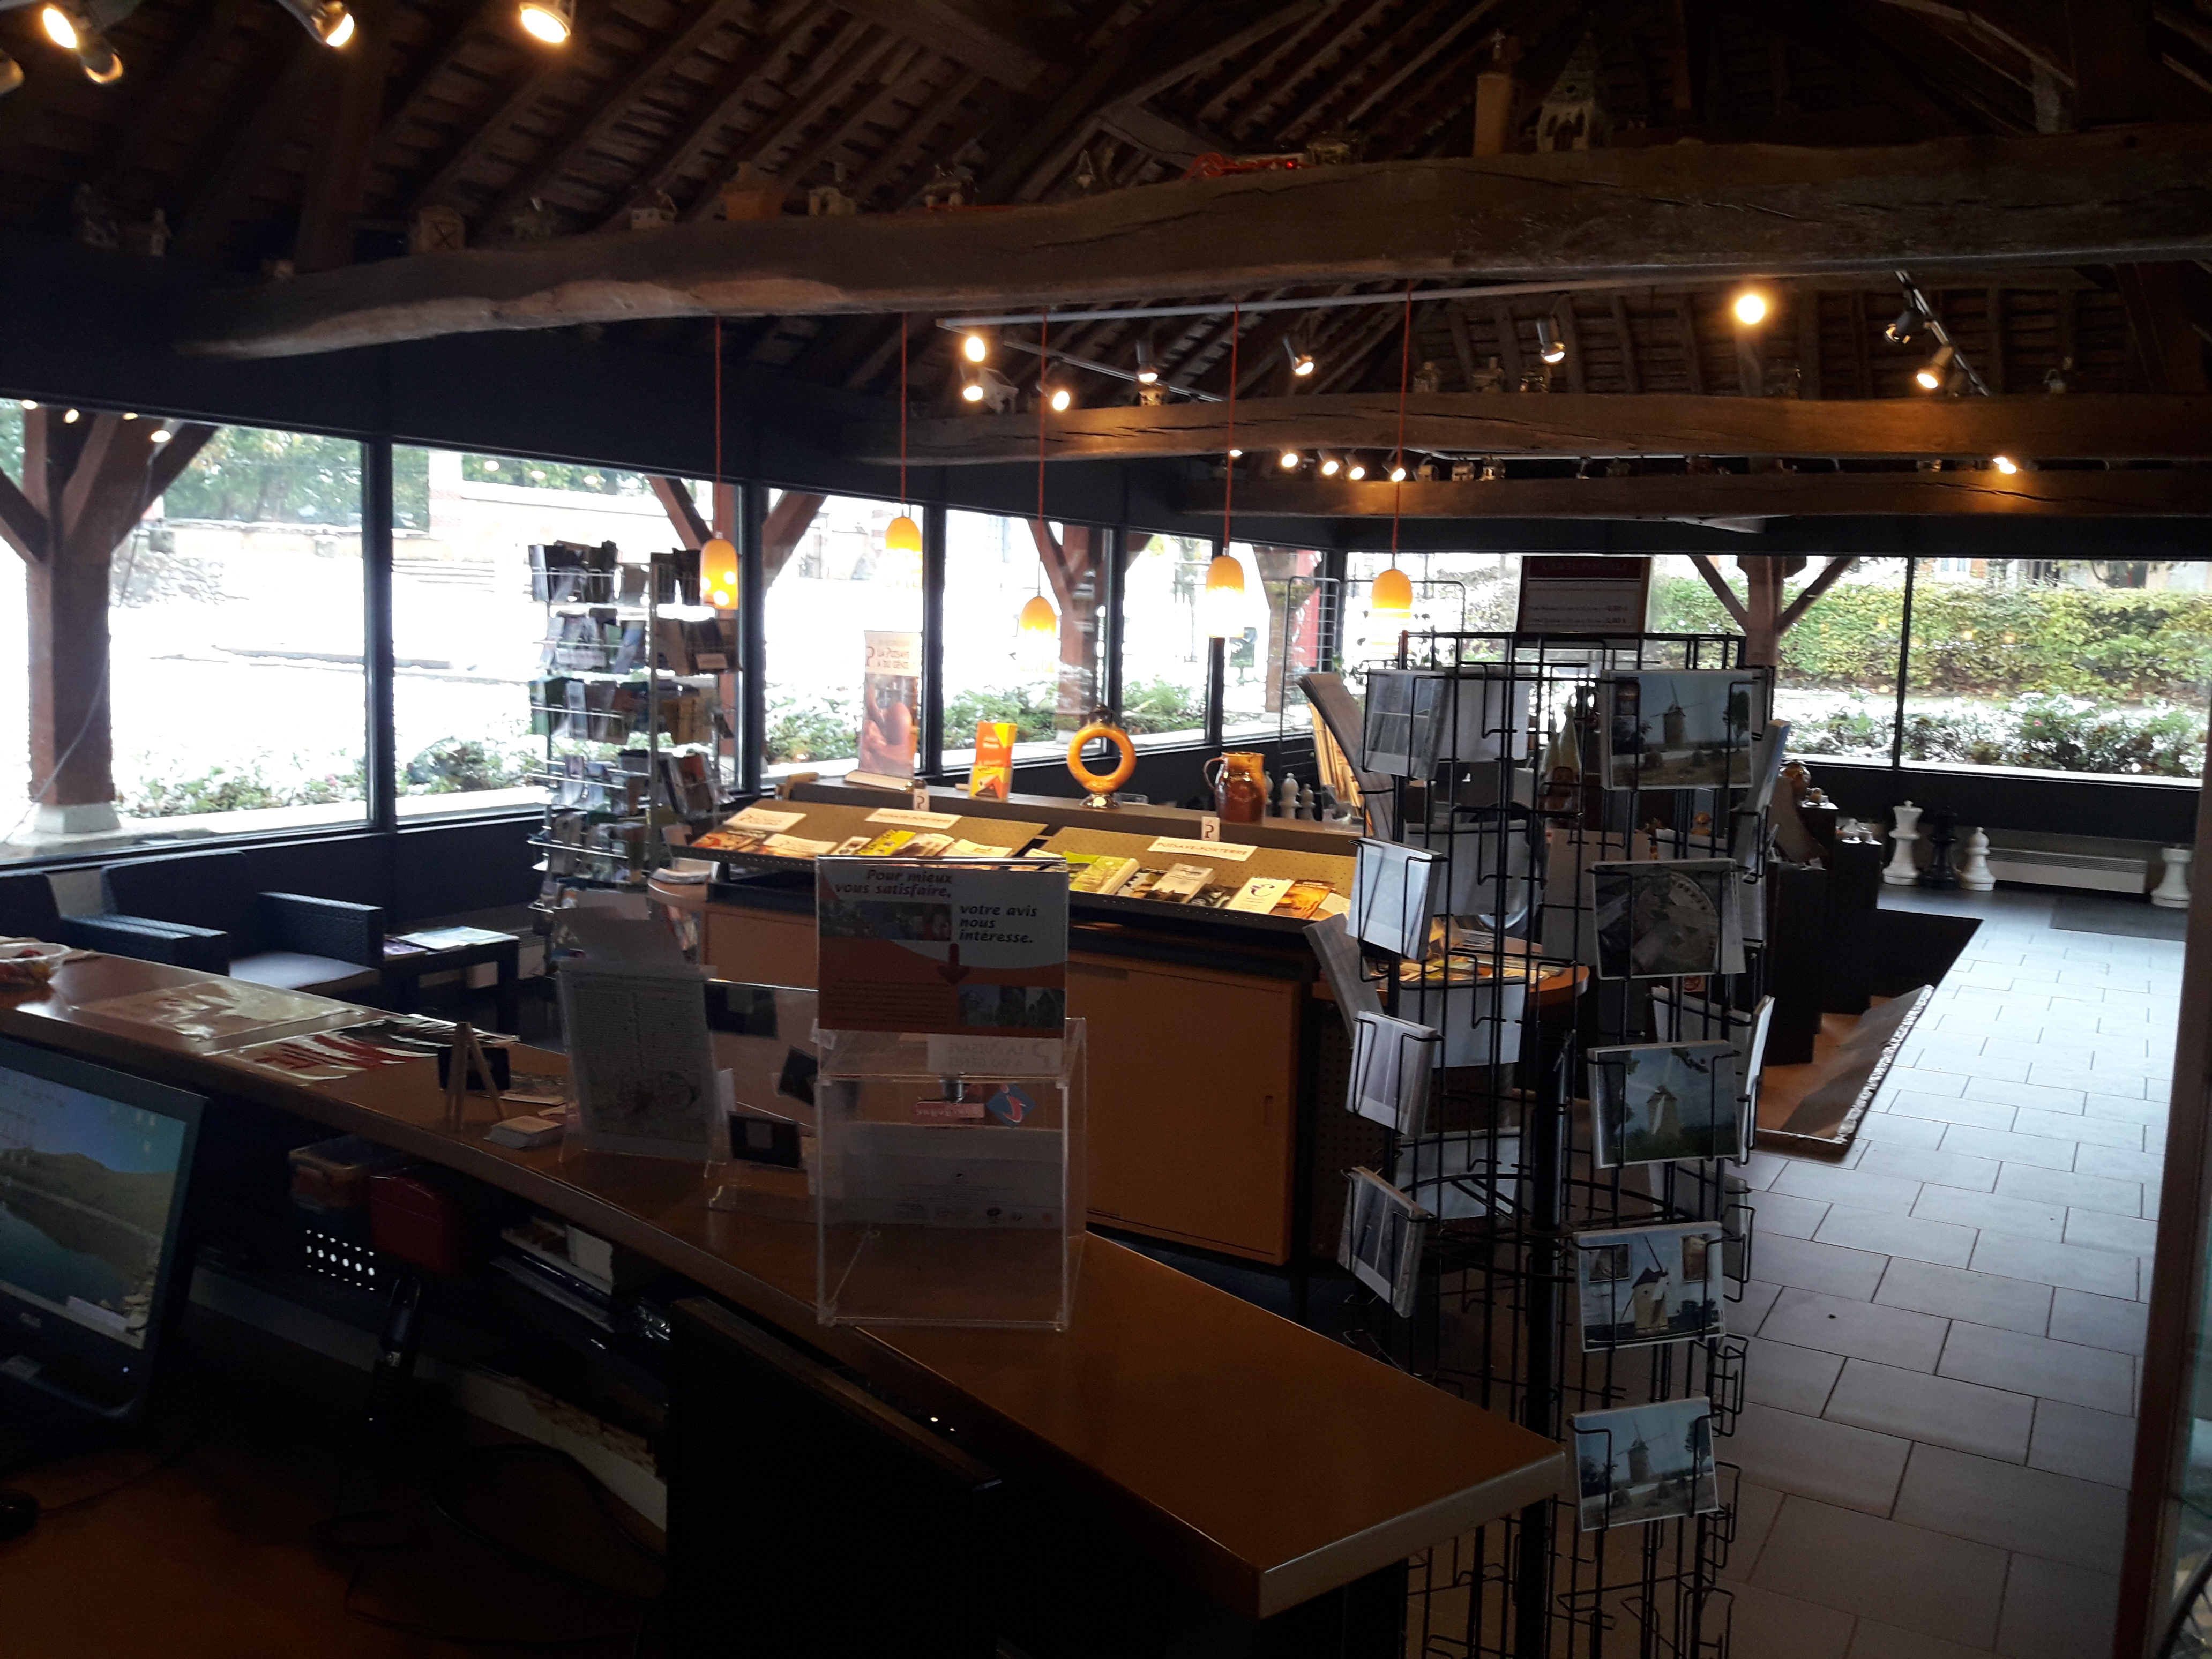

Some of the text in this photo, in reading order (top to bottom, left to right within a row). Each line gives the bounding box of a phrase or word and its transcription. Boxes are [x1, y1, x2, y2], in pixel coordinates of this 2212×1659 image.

[867, 869, 952, 883] Pour mieux
[835, 883, 951, 898] vous satisfaire,
[960, 905, 1037, 917] votre avis
[960, 918, 996, 928] nous
